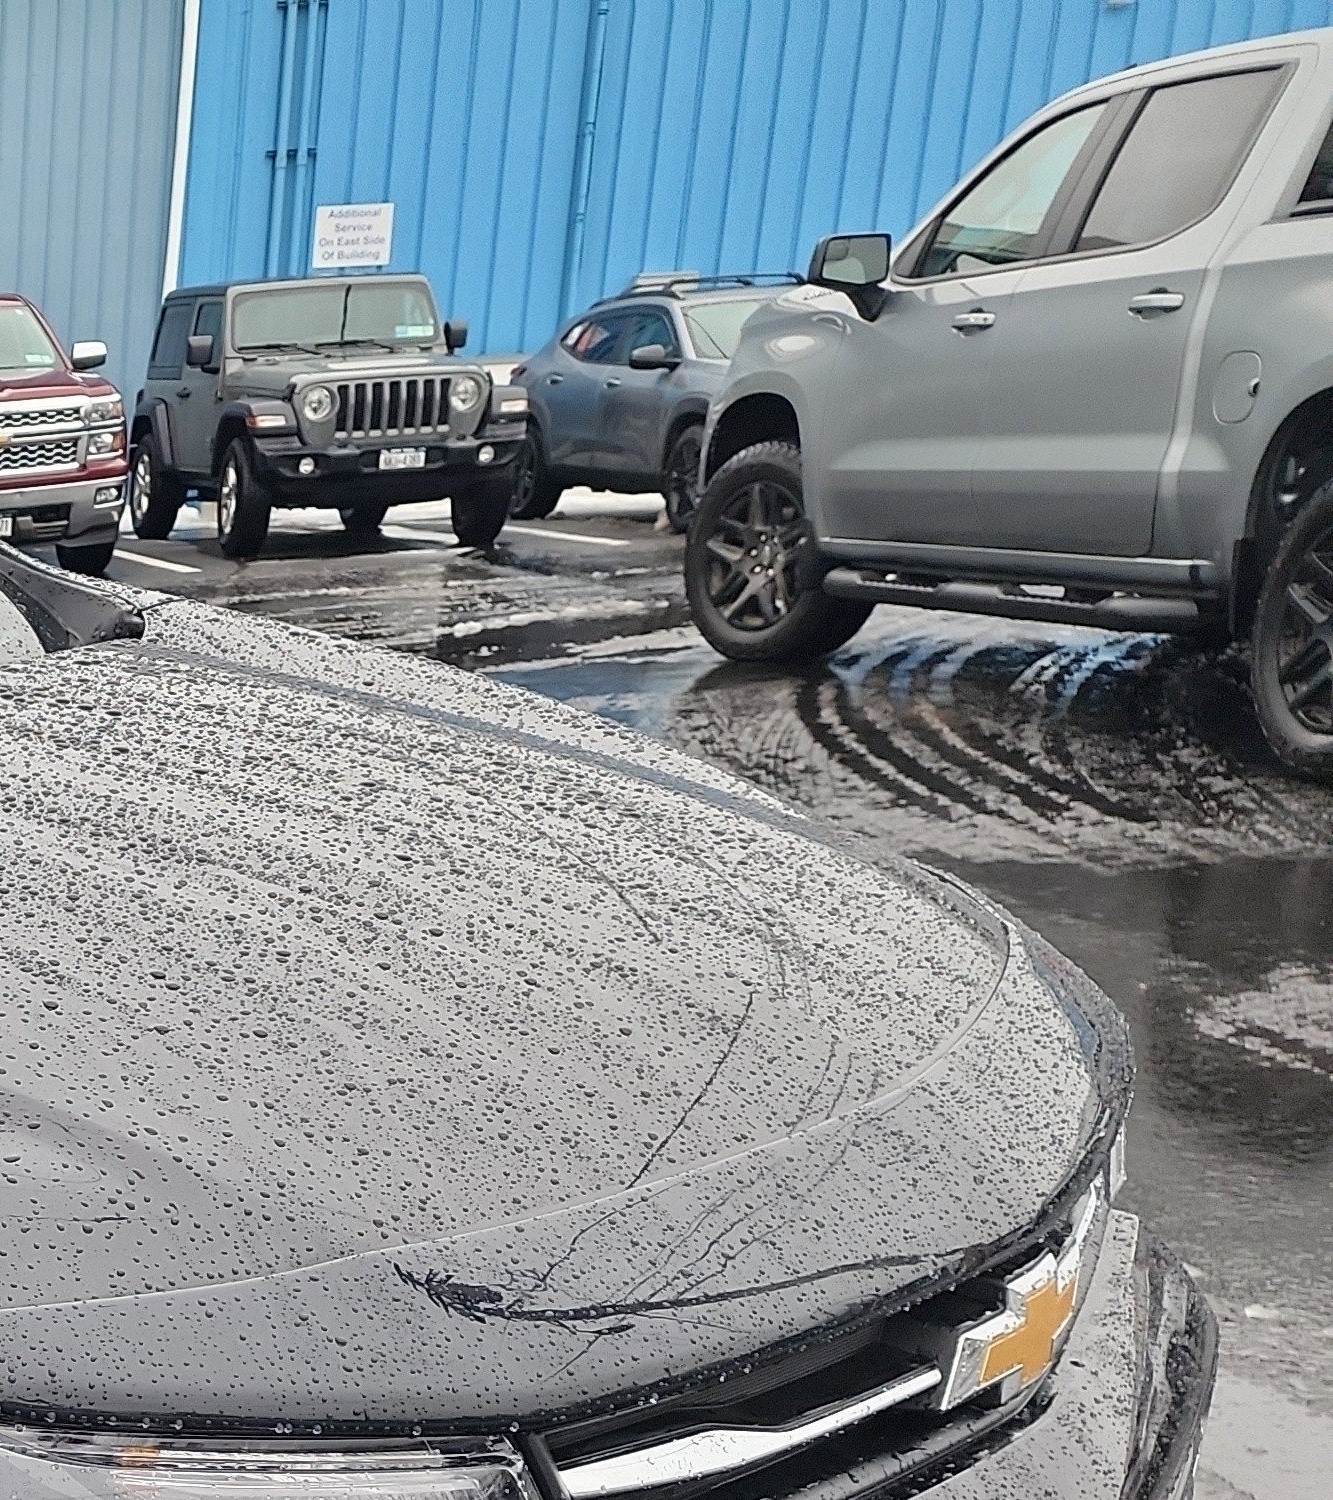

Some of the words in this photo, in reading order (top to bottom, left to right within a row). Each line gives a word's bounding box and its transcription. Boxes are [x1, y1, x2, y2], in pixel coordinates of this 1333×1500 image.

[334, 222, 373, 232] Service
[319, 237, 334, 247] On
[337, 236, 360, 247] East
[337, 249, 380, 261] Building
